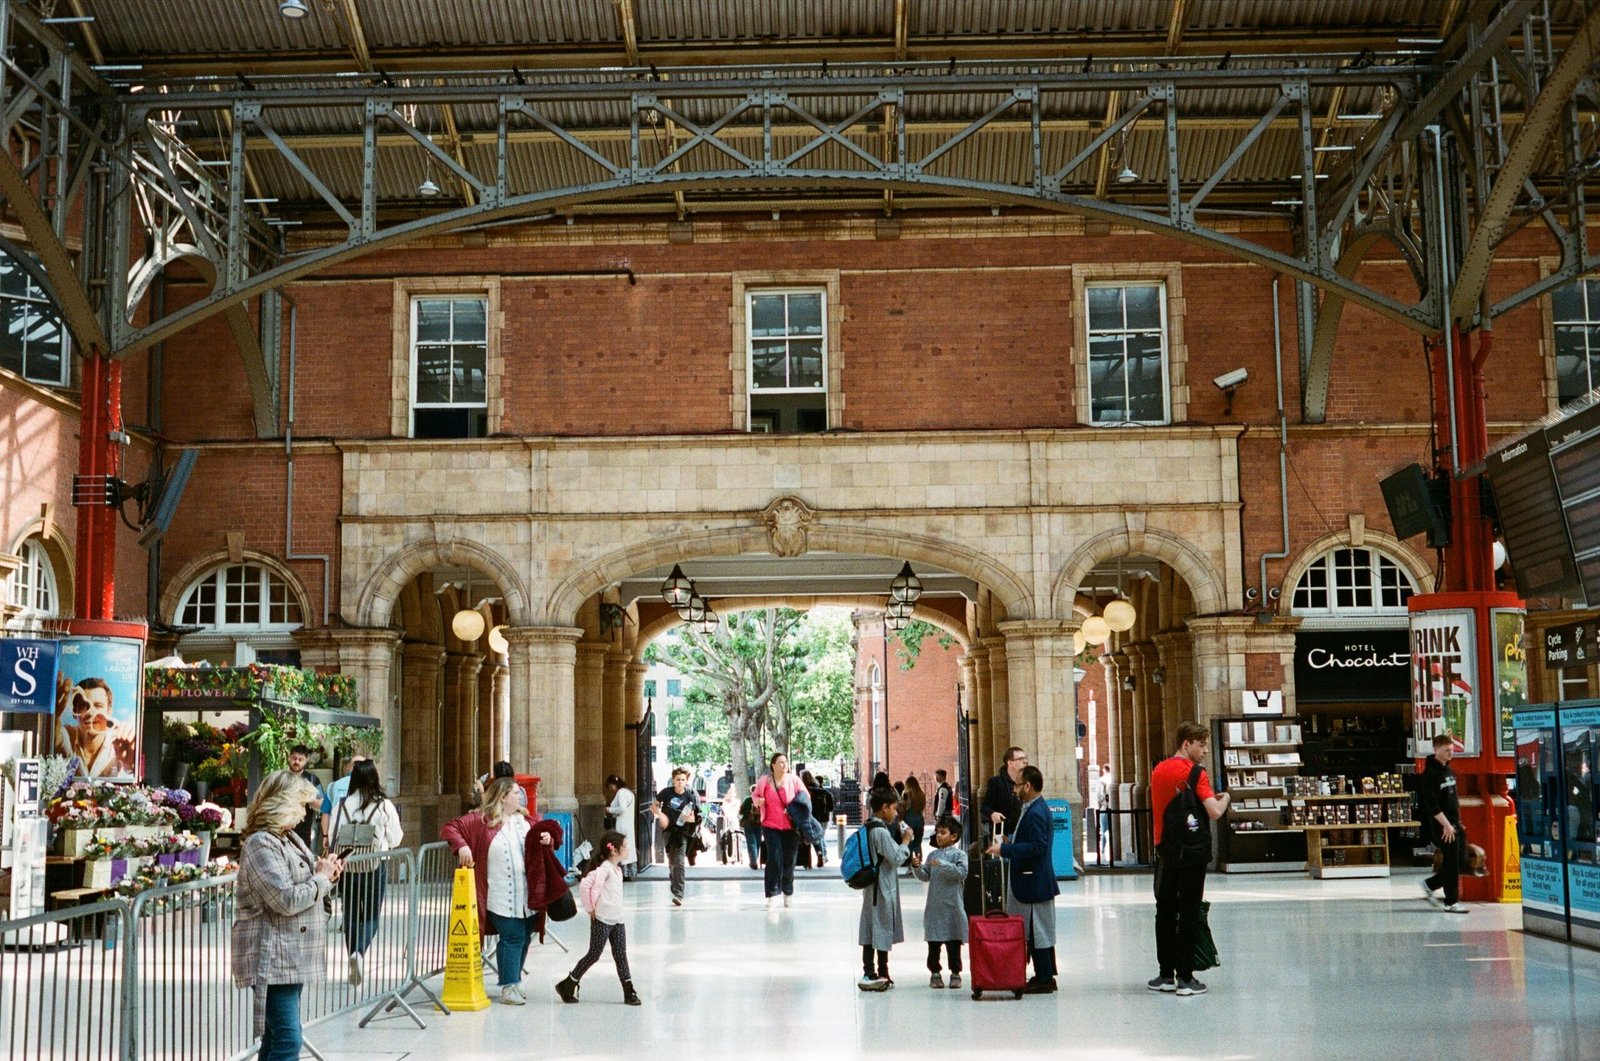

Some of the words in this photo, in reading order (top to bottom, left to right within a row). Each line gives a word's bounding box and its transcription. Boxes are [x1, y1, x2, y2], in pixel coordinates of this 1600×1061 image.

[1501, 443, 1528, 463] Information
[1548, 633, 1562, 647] Cycle
[16, 646, 39, 659] WH
[1308, 648, 1411, 669] Chocolat
[1548, 648, 1568, 661] Parking
[11, 657, 37, 697] S
[181, 688, 236, 697] FLOWERS
